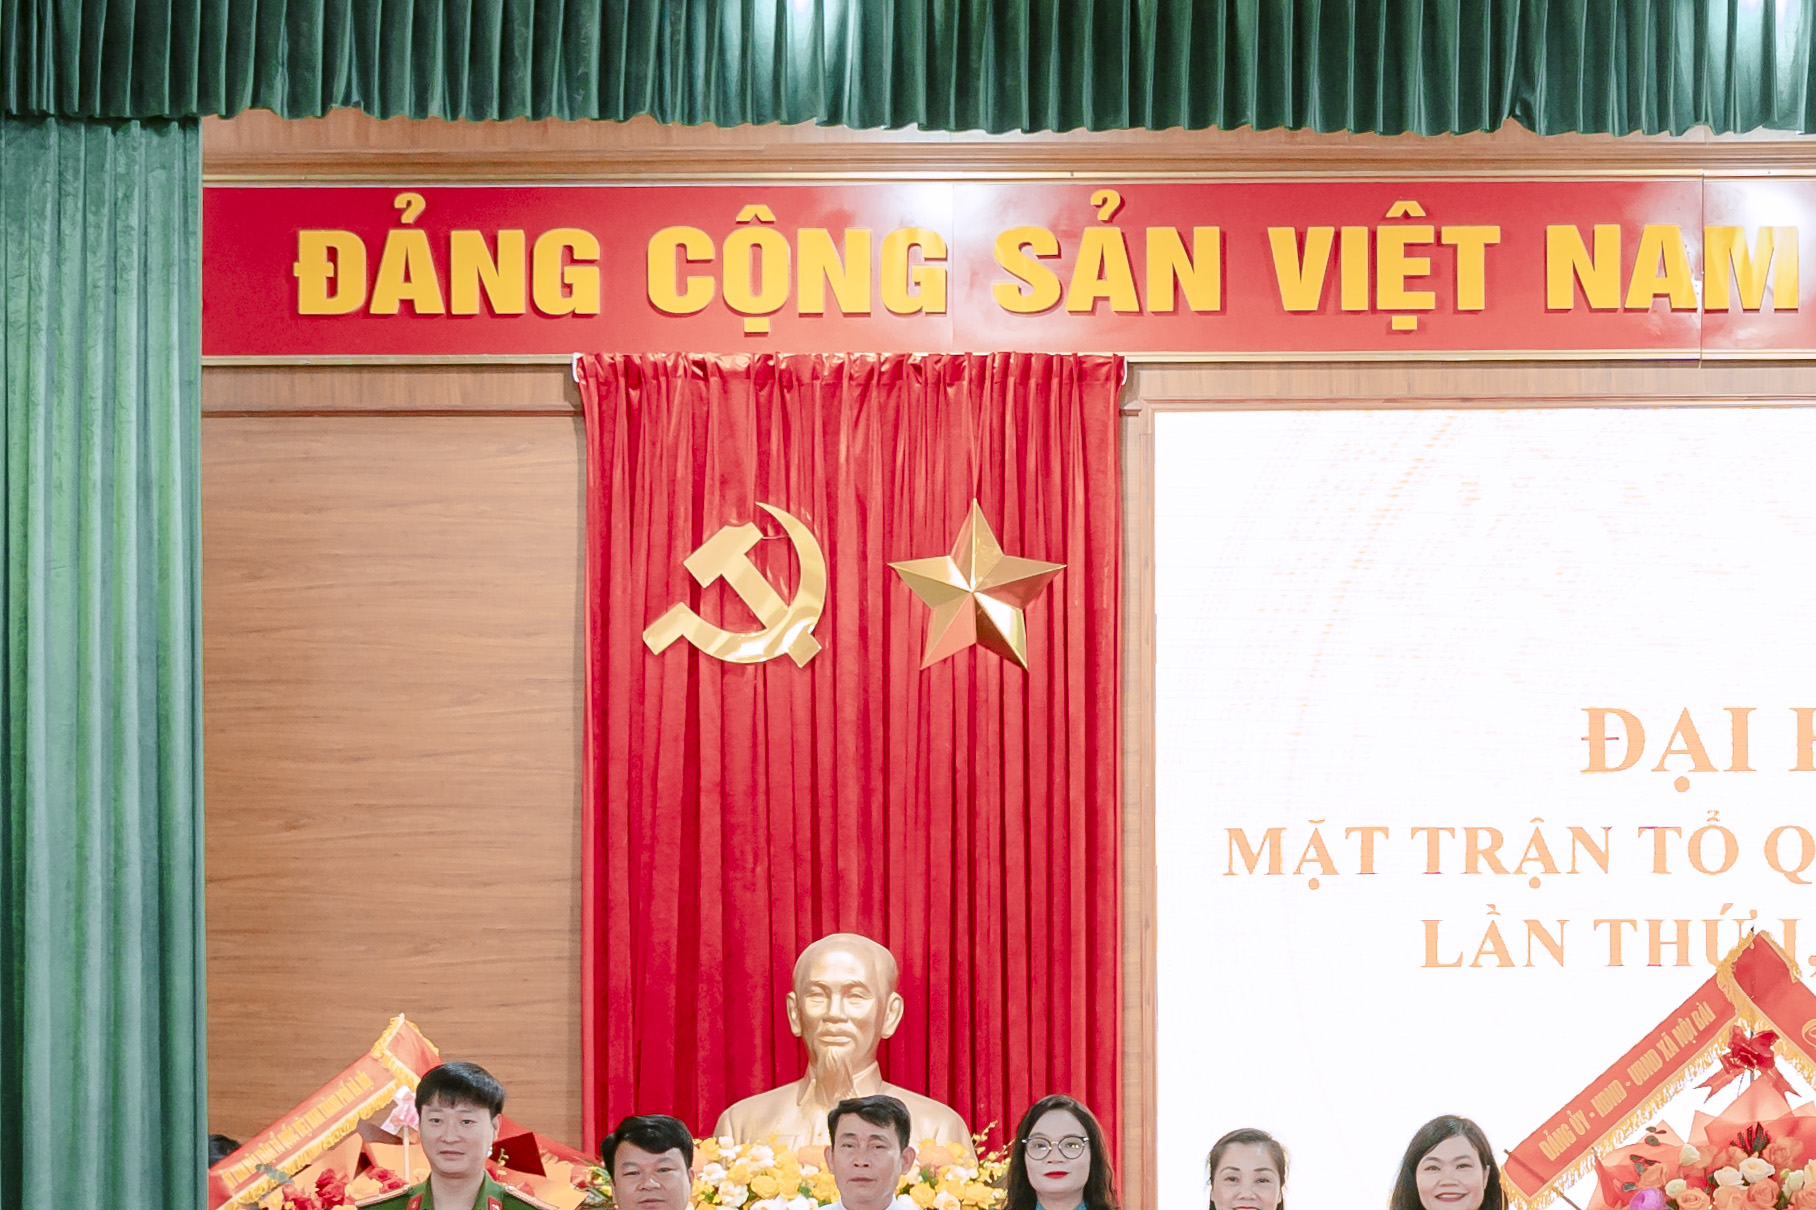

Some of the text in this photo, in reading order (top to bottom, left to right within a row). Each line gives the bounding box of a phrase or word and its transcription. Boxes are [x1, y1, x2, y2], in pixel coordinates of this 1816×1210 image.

[293, 193, 600, 315] ĐẢNG
[647, 205, 947, 333] CỘNG
[992, 190, 1220, 313] SẢN
[1268, 201, 1500, 331] VIỆT
[1546, 224, 1800, 310] NAM
[1580, 706, 1757, 792] ĐẠI
[1223, 818, 1390, 891] MẶT
[1410, 816, 1612, 889] TRẬN
[1637, 809, 1739, 876] TỔ
[1420, 903, 1570, 968] LẦN
[1626, 1048, 1665, 1085] UBND
[1655, 1033, 1678, 1060] XÃ
[1671, 1018, 1699, 1046] NỘI
[1689, 1002, 1716, 1029] BÀI
